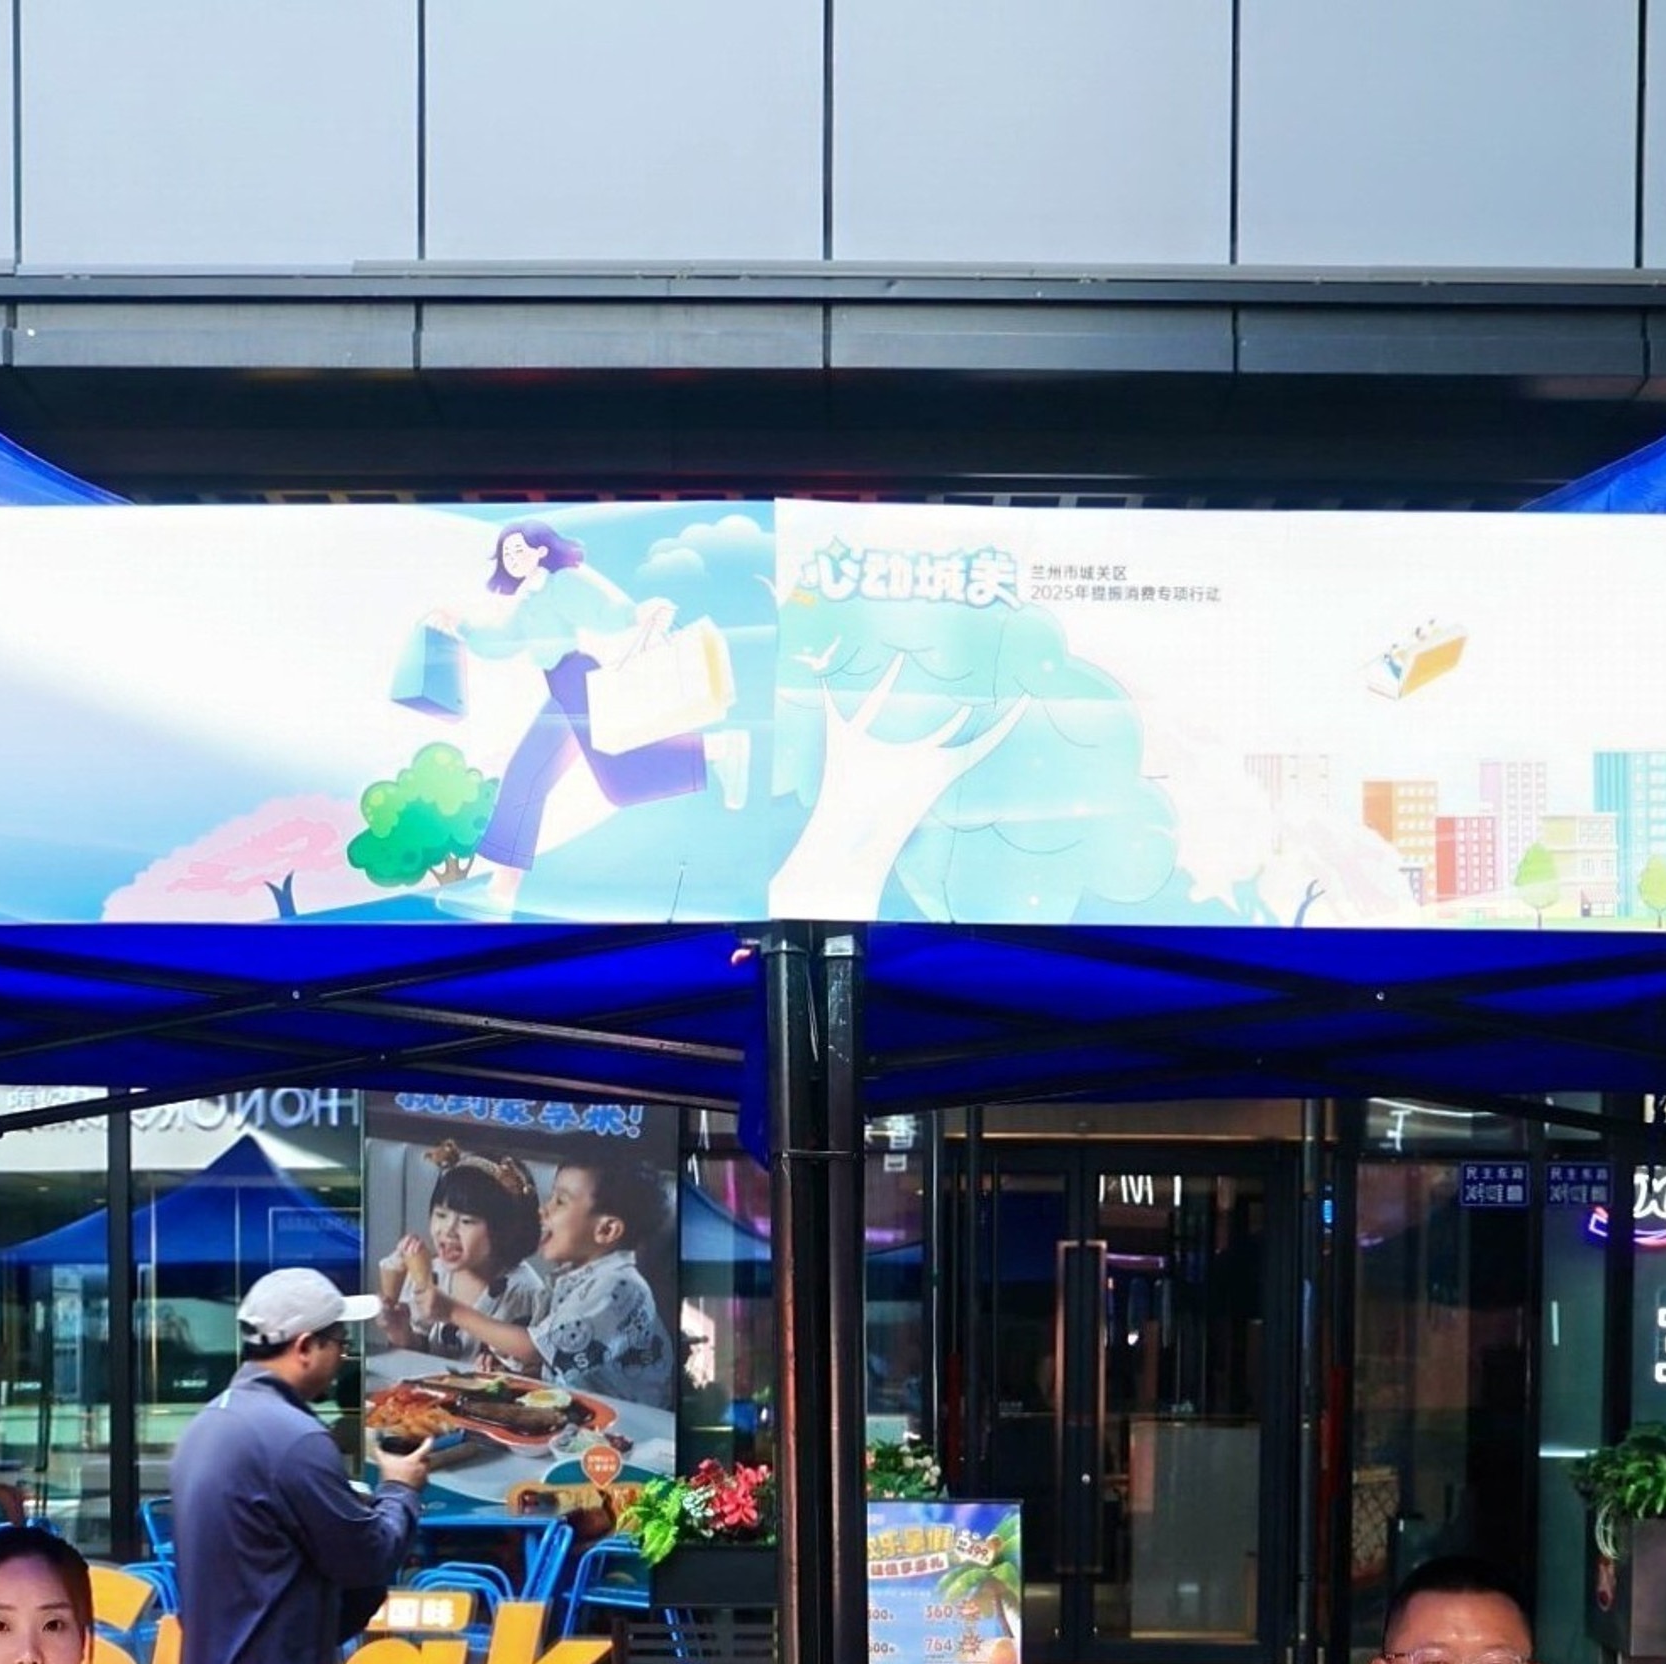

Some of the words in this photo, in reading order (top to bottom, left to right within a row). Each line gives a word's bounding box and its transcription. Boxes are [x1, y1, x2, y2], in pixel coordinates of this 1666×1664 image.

[803, 540, 1023, 610] 心动城关
[1031, 565, 1128, 582] 兰州市城关区
[1031, 585, 1222, 602] 2025年提振消费专项行动
